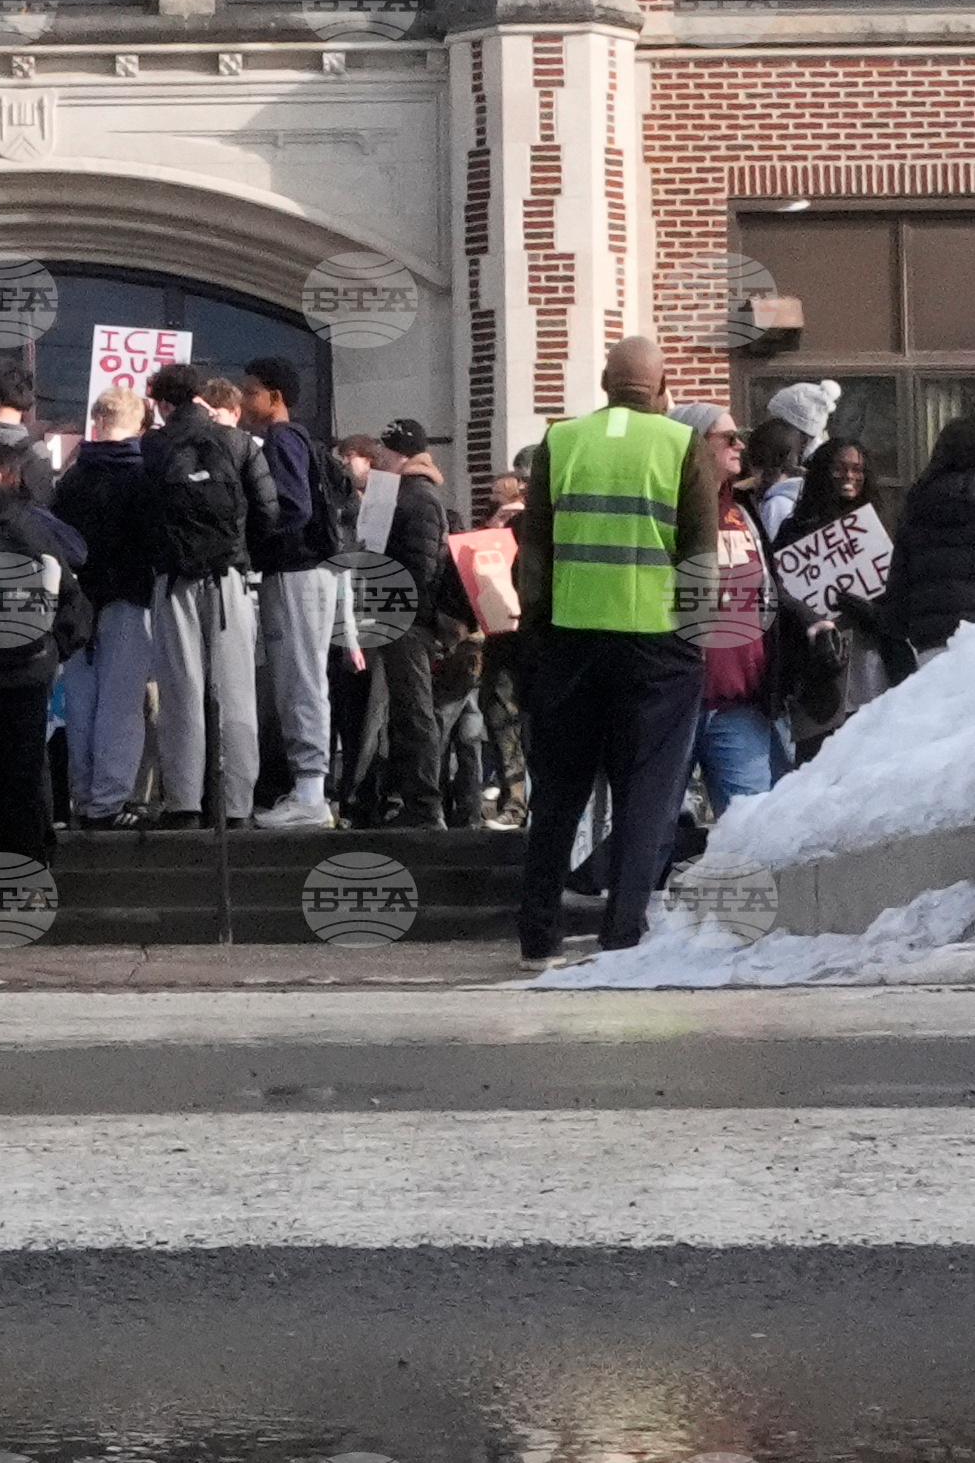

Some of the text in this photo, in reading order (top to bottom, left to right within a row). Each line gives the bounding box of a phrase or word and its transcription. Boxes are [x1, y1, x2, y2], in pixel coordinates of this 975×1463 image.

[100, 330, 177, 356] ICE
[780, 514, 868, 574] OWER
[796, 538, 865, 586] TO THE
